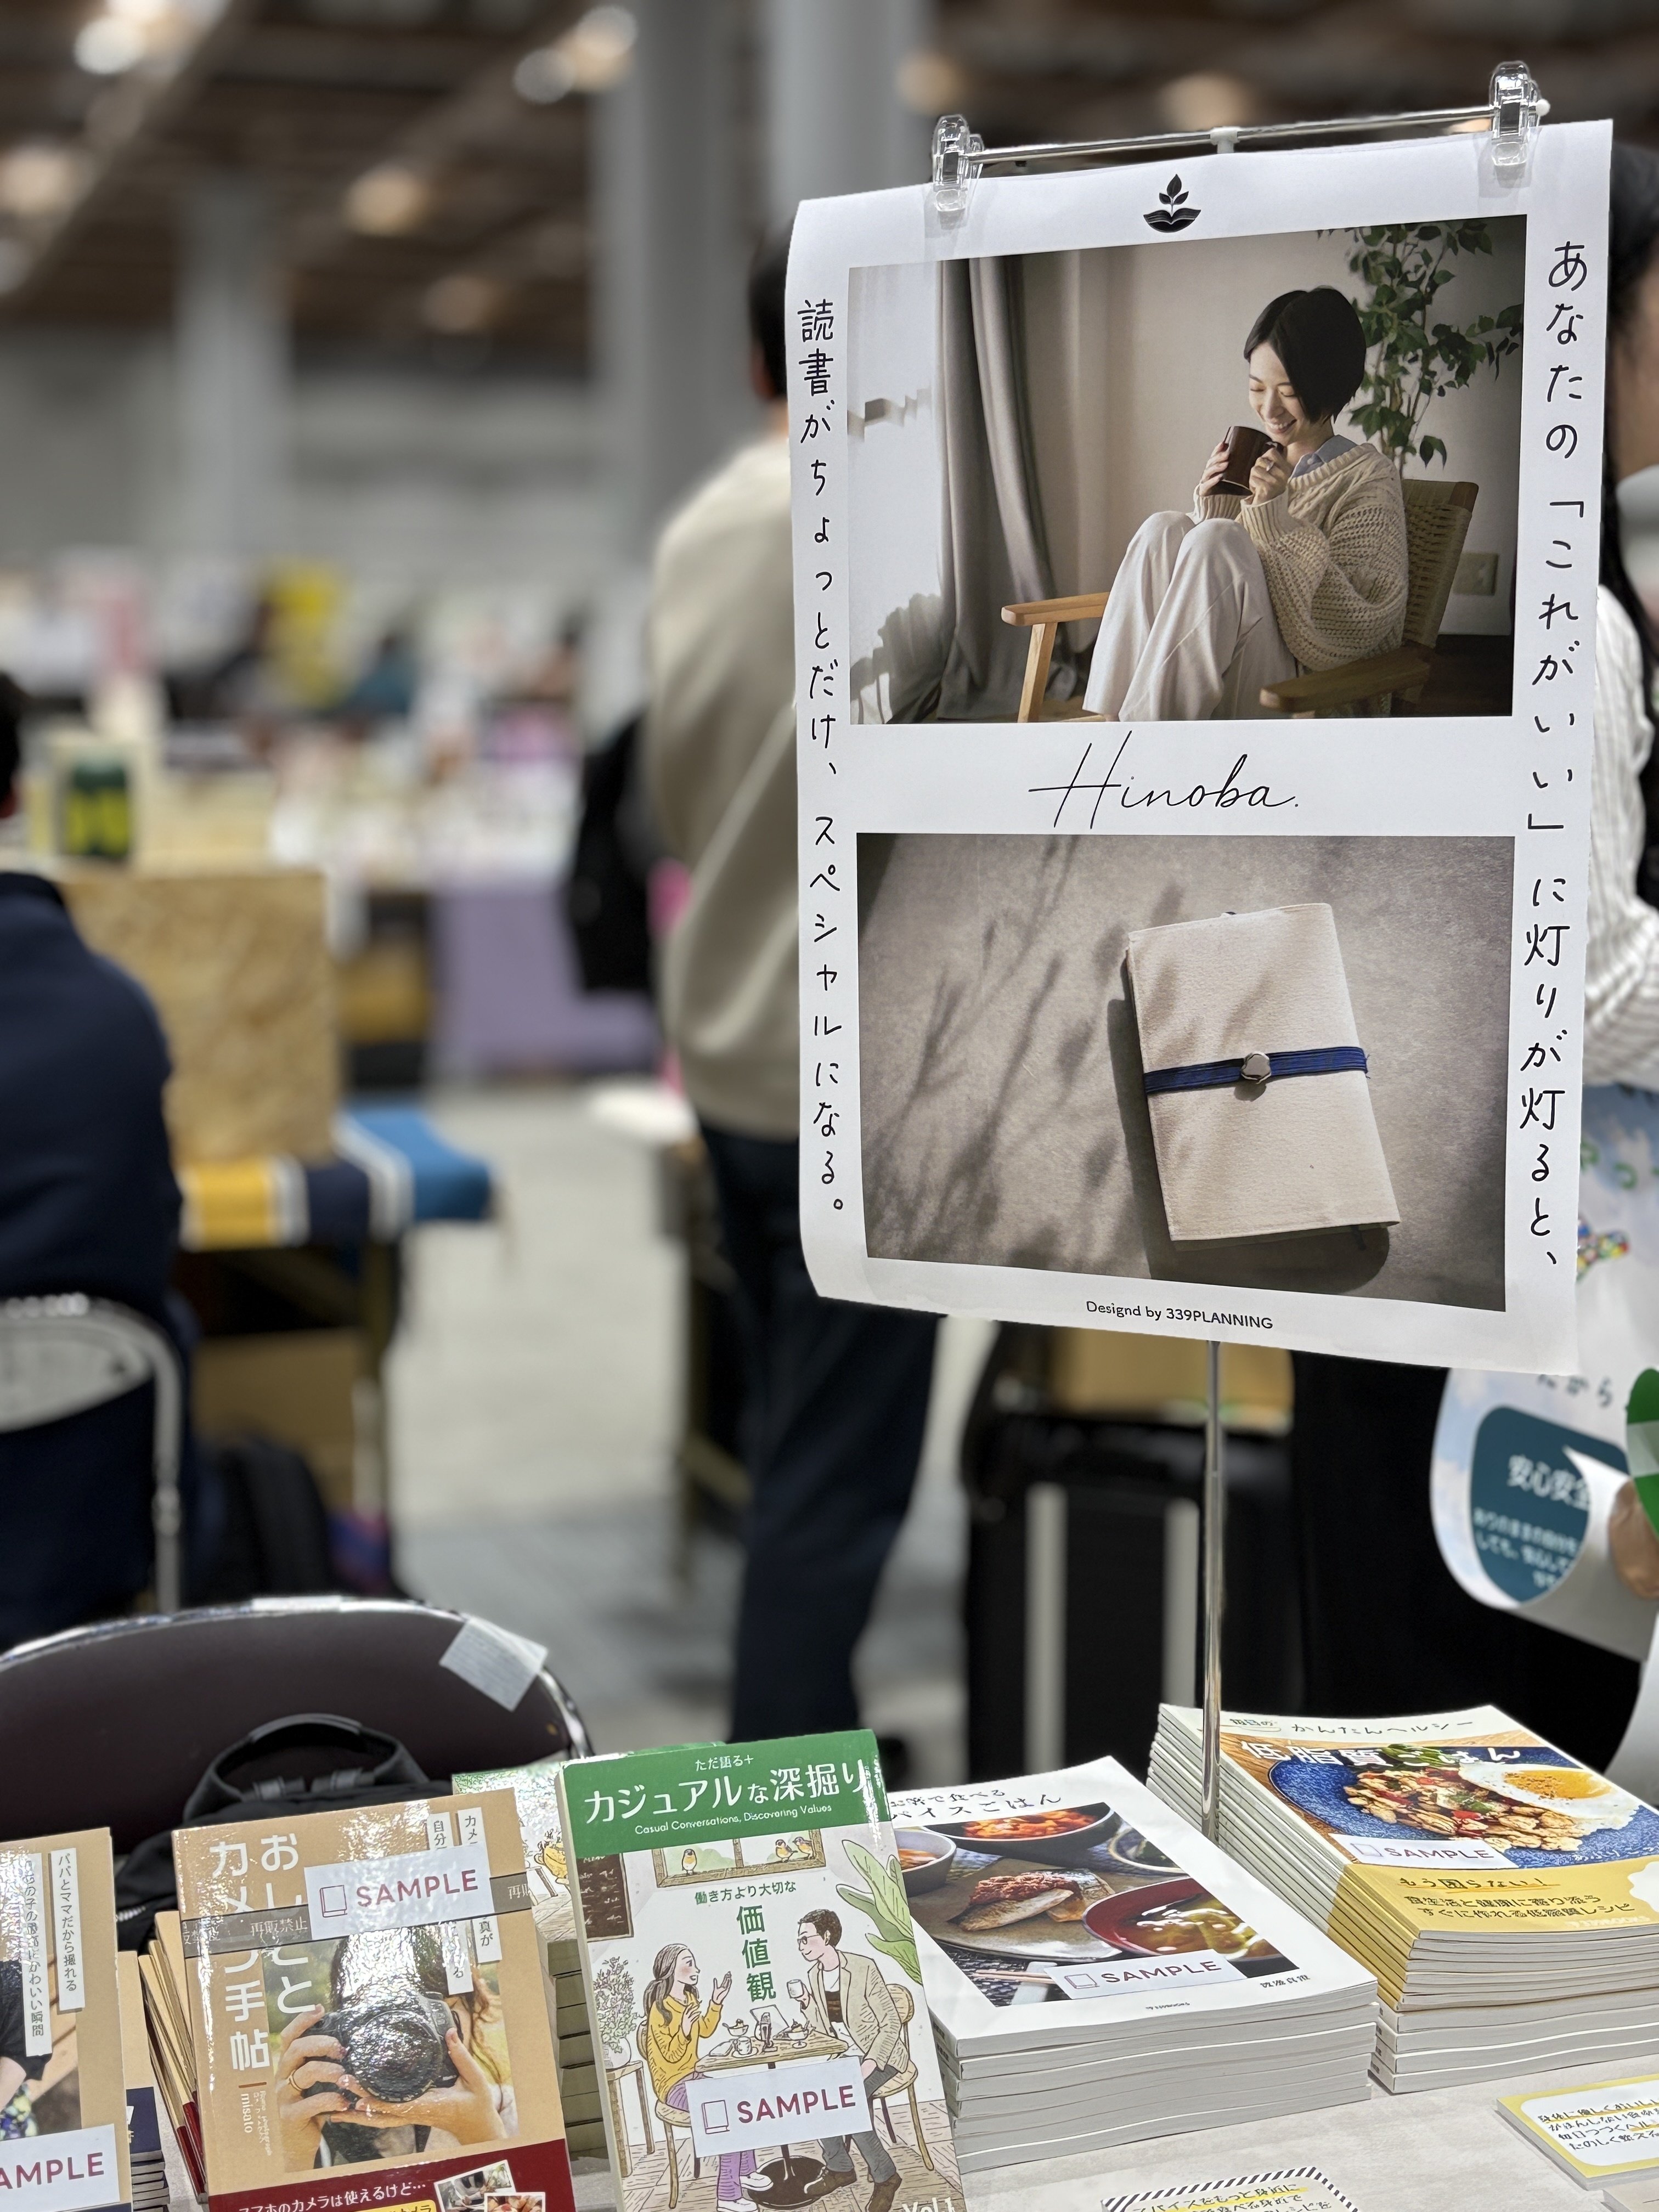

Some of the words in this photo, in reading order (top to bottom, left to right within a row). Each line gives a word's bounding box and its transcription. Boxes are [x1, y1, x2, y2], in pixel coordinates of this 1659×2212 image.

[797, 298, 843, 1210] 読書がちょっとだけ、スペシャルになる。
[1520, 240, 1587, 1265] あなたの「これがいい」に灯りが灯ると、
[1029, 730, 1299, 829] Hinoba.
[1086, 1301, 1141, 1317] Designd
[1146, 1306, 1161, 1321] by
[1166, 1308, 1273, 1329] 339PLANNING
[584, 1759, 866, 1824] カジュアルな深掘り
[635, 1821, 669, 1835] Casual
[672, 1814, 742, 1831] Conversations,
[744, 1808, 798, 1822] Discovering
[800, 1803, 832, 1815] Values
[1384, 1847, 1494, 1859] SAMPLE
[357, 1869, 478, 1907] SAMPLE
[695, 1881, 797, 1905] 働き方より大切な
[736, 1905, 777, 2002] 価値観
[1101, 1961, 1222, 1983] SAMPLE
[737, 2085, 856, 2124] SAMPLE
